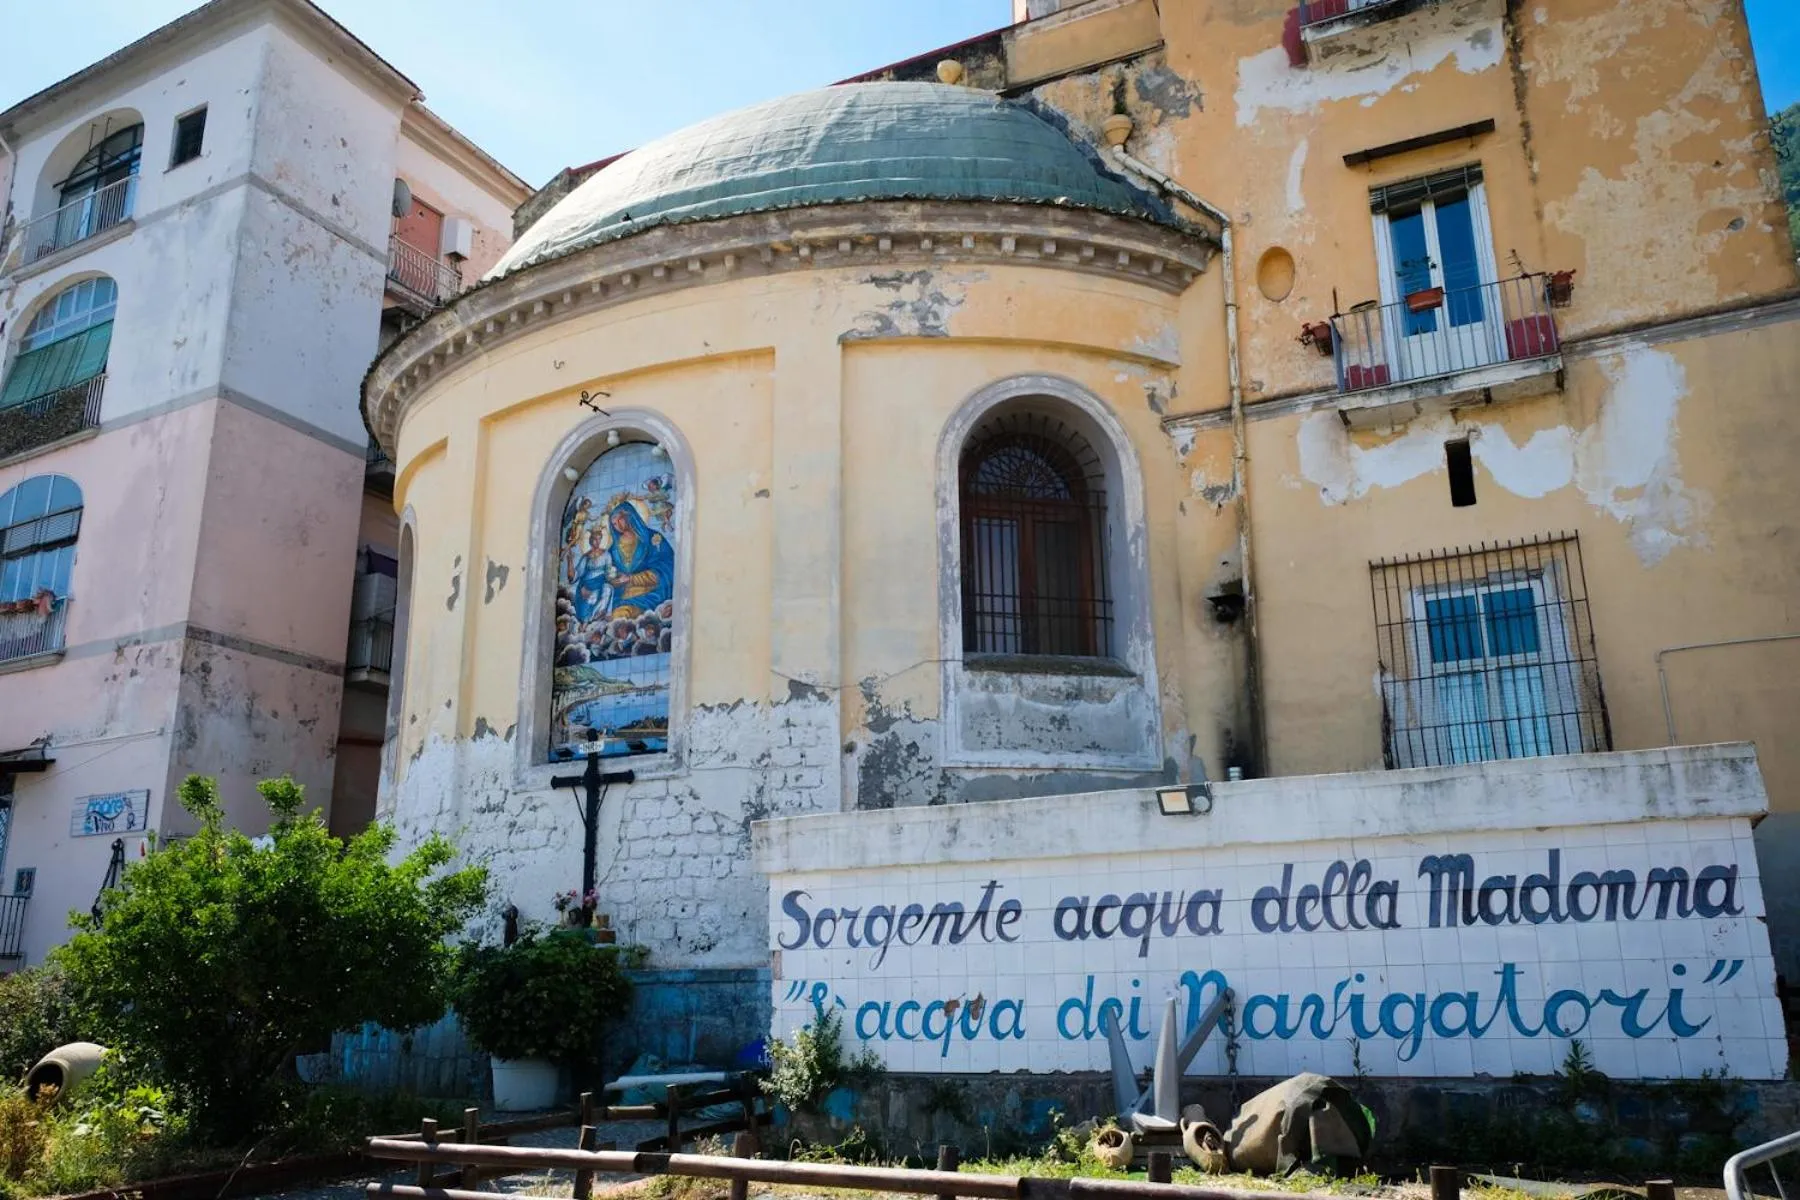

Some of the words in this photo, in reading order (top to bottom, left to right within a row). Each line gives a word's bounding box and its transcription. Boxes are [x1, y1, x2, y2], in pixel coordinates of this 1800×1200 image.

[778, 880, 1022, 971] Sorgente
[1053, 888, 1224, 958] acqua
[1251, 858, 1402, 934] della
[1418, 848, 1744, 928] Madonna
[1057, 975, 1150, 1041] dei
